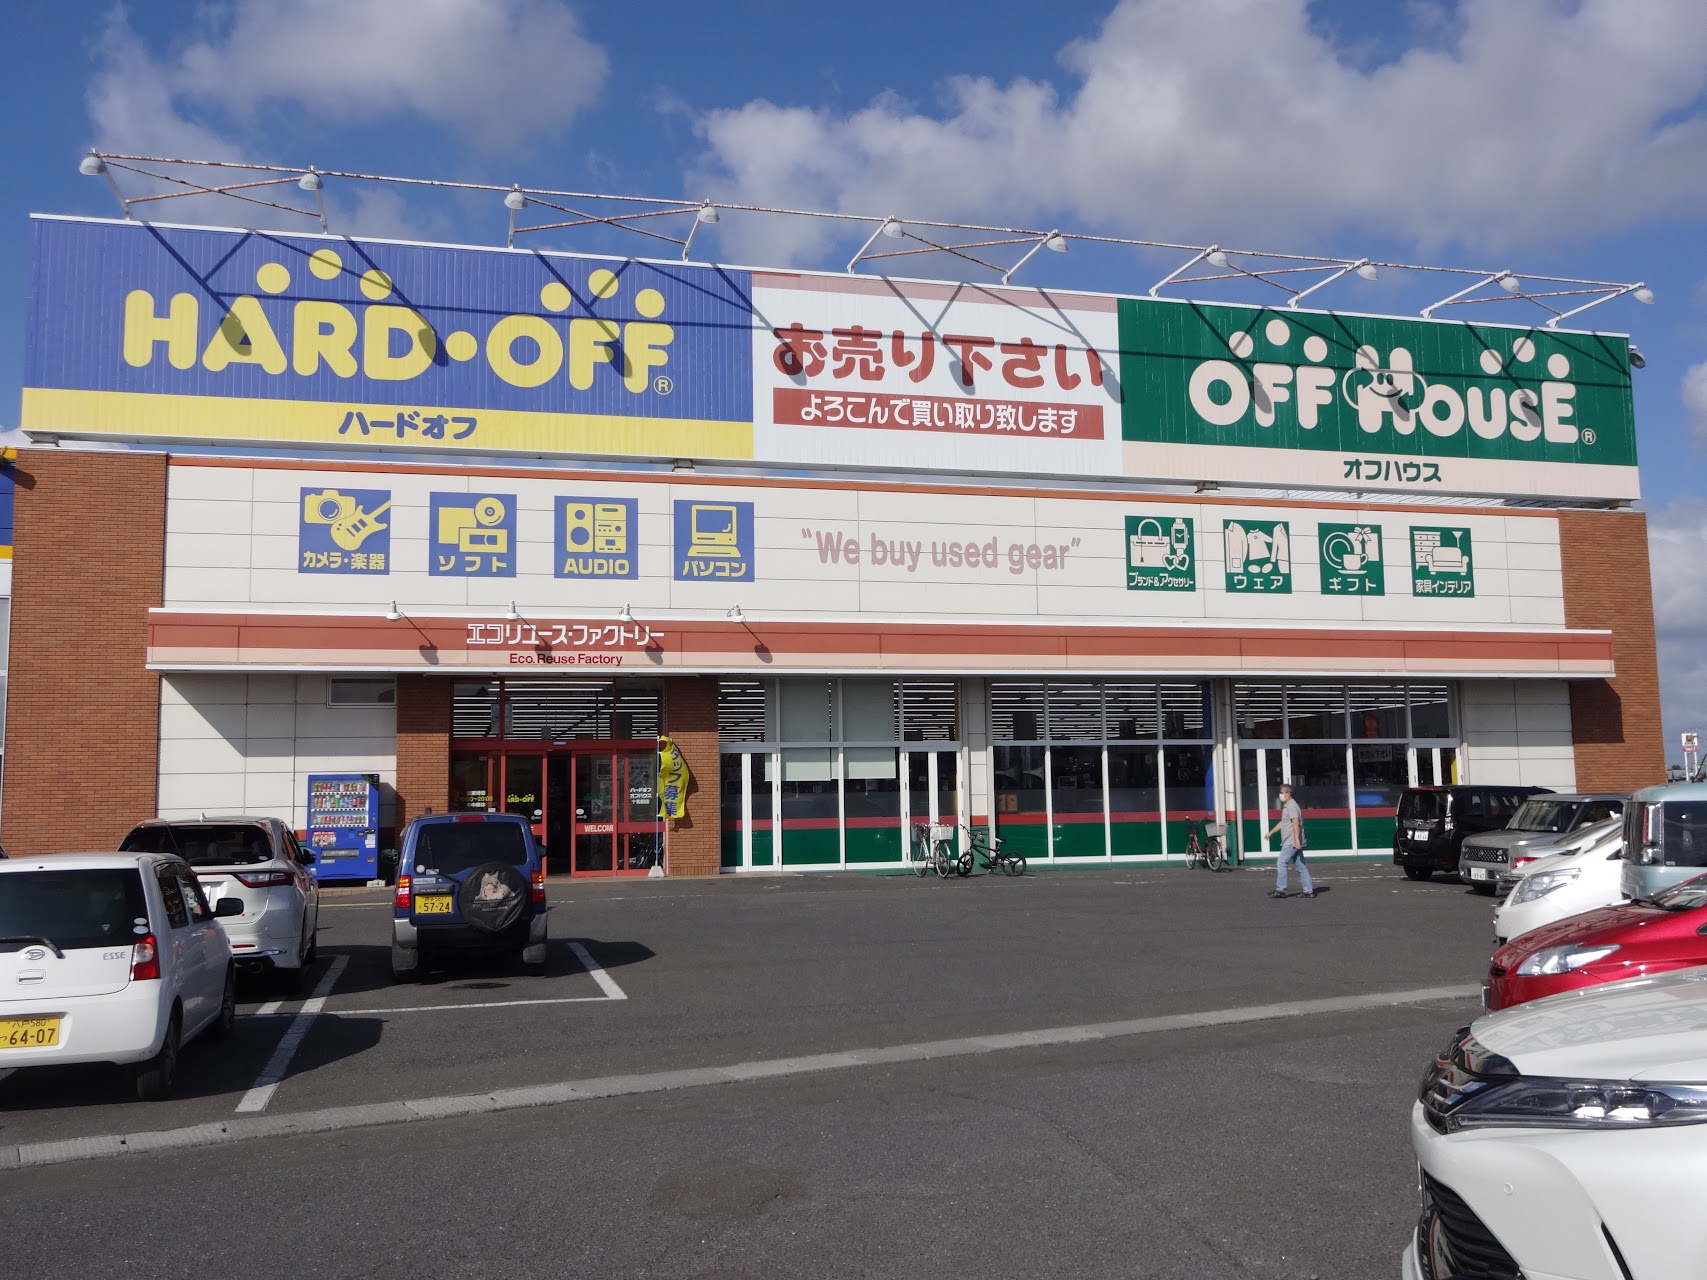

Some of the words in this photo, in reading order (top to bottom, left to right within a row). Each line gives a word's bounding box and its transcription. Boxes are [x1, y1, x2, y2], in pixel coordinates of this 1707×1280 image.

[773, 322, 1103, 390] お売り下さい
[1189, 359, 1336, 429] OFF
[801, 394, 1078, 434] よろこんで買い取り致します
[338, 412, 478, 440] ハードオフ
[1343, 459, 1442, 483] オフハウス
[303, 551, 385, 570] カメラ・楽器
[871, 532, 922, 572] buy
[931, 536, 998, 569] used
[438, 556, 507, 573] ソフト
[563, 558, 630, 575] AUDIO
[682, 560, 747, 577] パソコン
[1328, 578, 1376, 592] ギフト
[1415, 579, 1471, 594] 家具インテリア
[538, 653, 575, 664] Reuse
[578, 653, 623, 667] Factory
[664, 741, 682, 817] タッフ募集
[584, 824, 614, 832] WELCOM
[423, 902, 451, 912] 57-24
[103, 951, 126, 960] ESSE
[10, 1028, 56, 1045] 64-07
